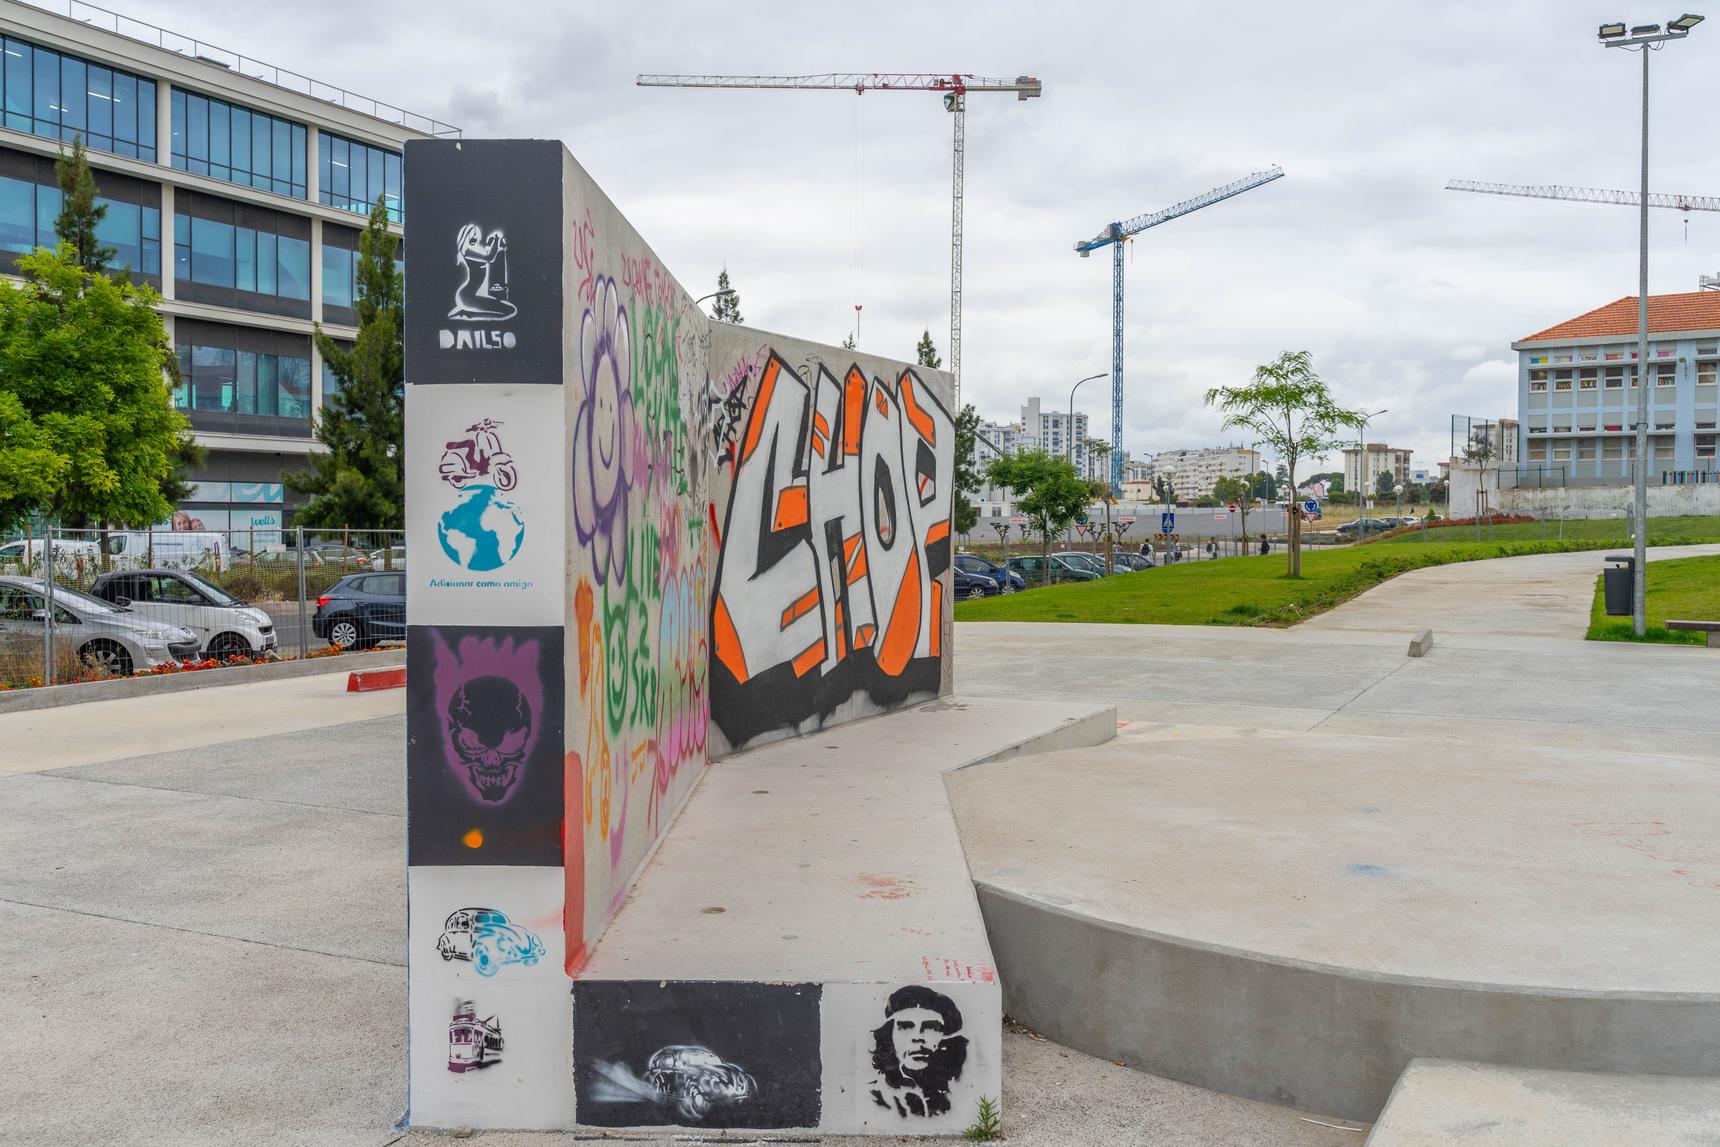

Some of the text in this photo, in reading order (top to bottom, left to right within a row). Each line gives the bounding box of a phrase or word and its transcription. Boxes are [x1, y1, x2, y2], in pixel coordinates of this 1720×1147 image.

[476, 580, 502, 588] como
[639, 602, 650, 659] 2
[630, 648, 656, 728] SK8
